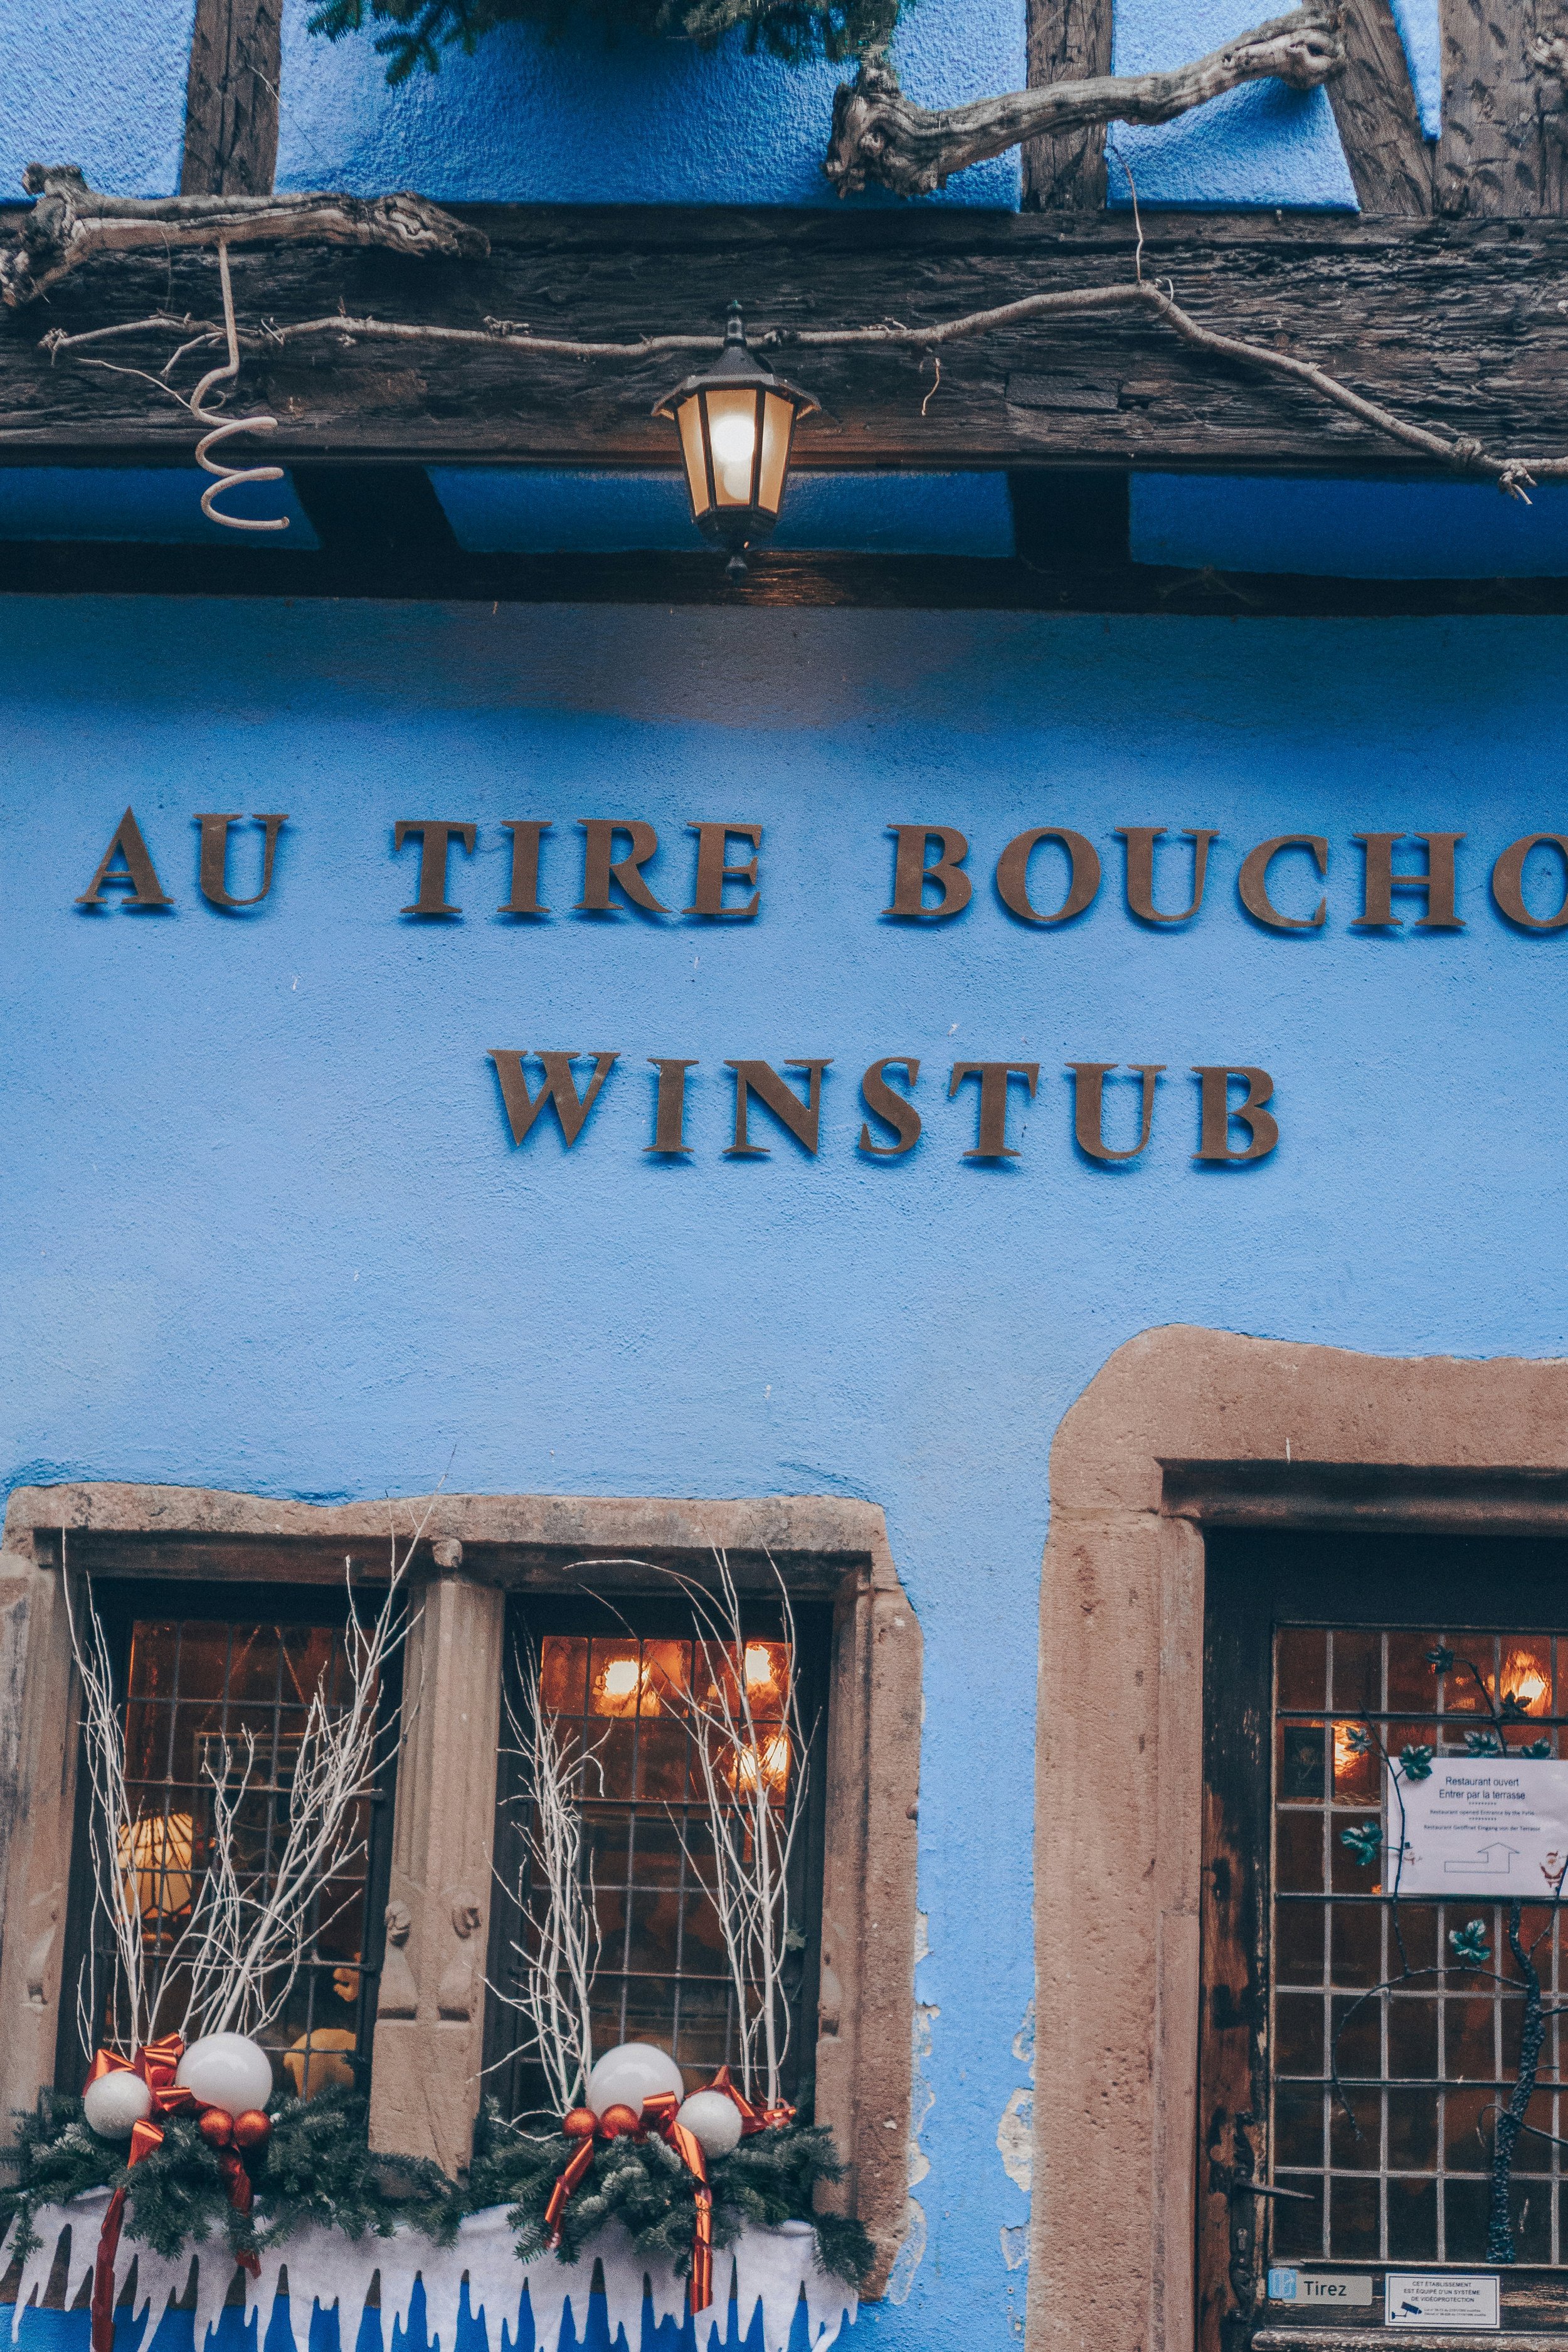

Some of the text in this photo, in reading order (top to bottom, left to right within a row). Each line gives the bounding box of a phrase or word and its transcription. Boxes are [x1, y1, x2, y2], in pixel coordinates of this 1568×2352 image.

[73, 805, 289, 906] AU
[395, 819, 763, 916] TIRE
[487, 1049, 1279, 1160] WINSTUB
[1446, 1776, 1519, 1786] Restaurant ouvert
[1439, 1789, 1525, 1802] Entrer par la terrasse
[1303, 2280, 1347, 2296] Tirez
